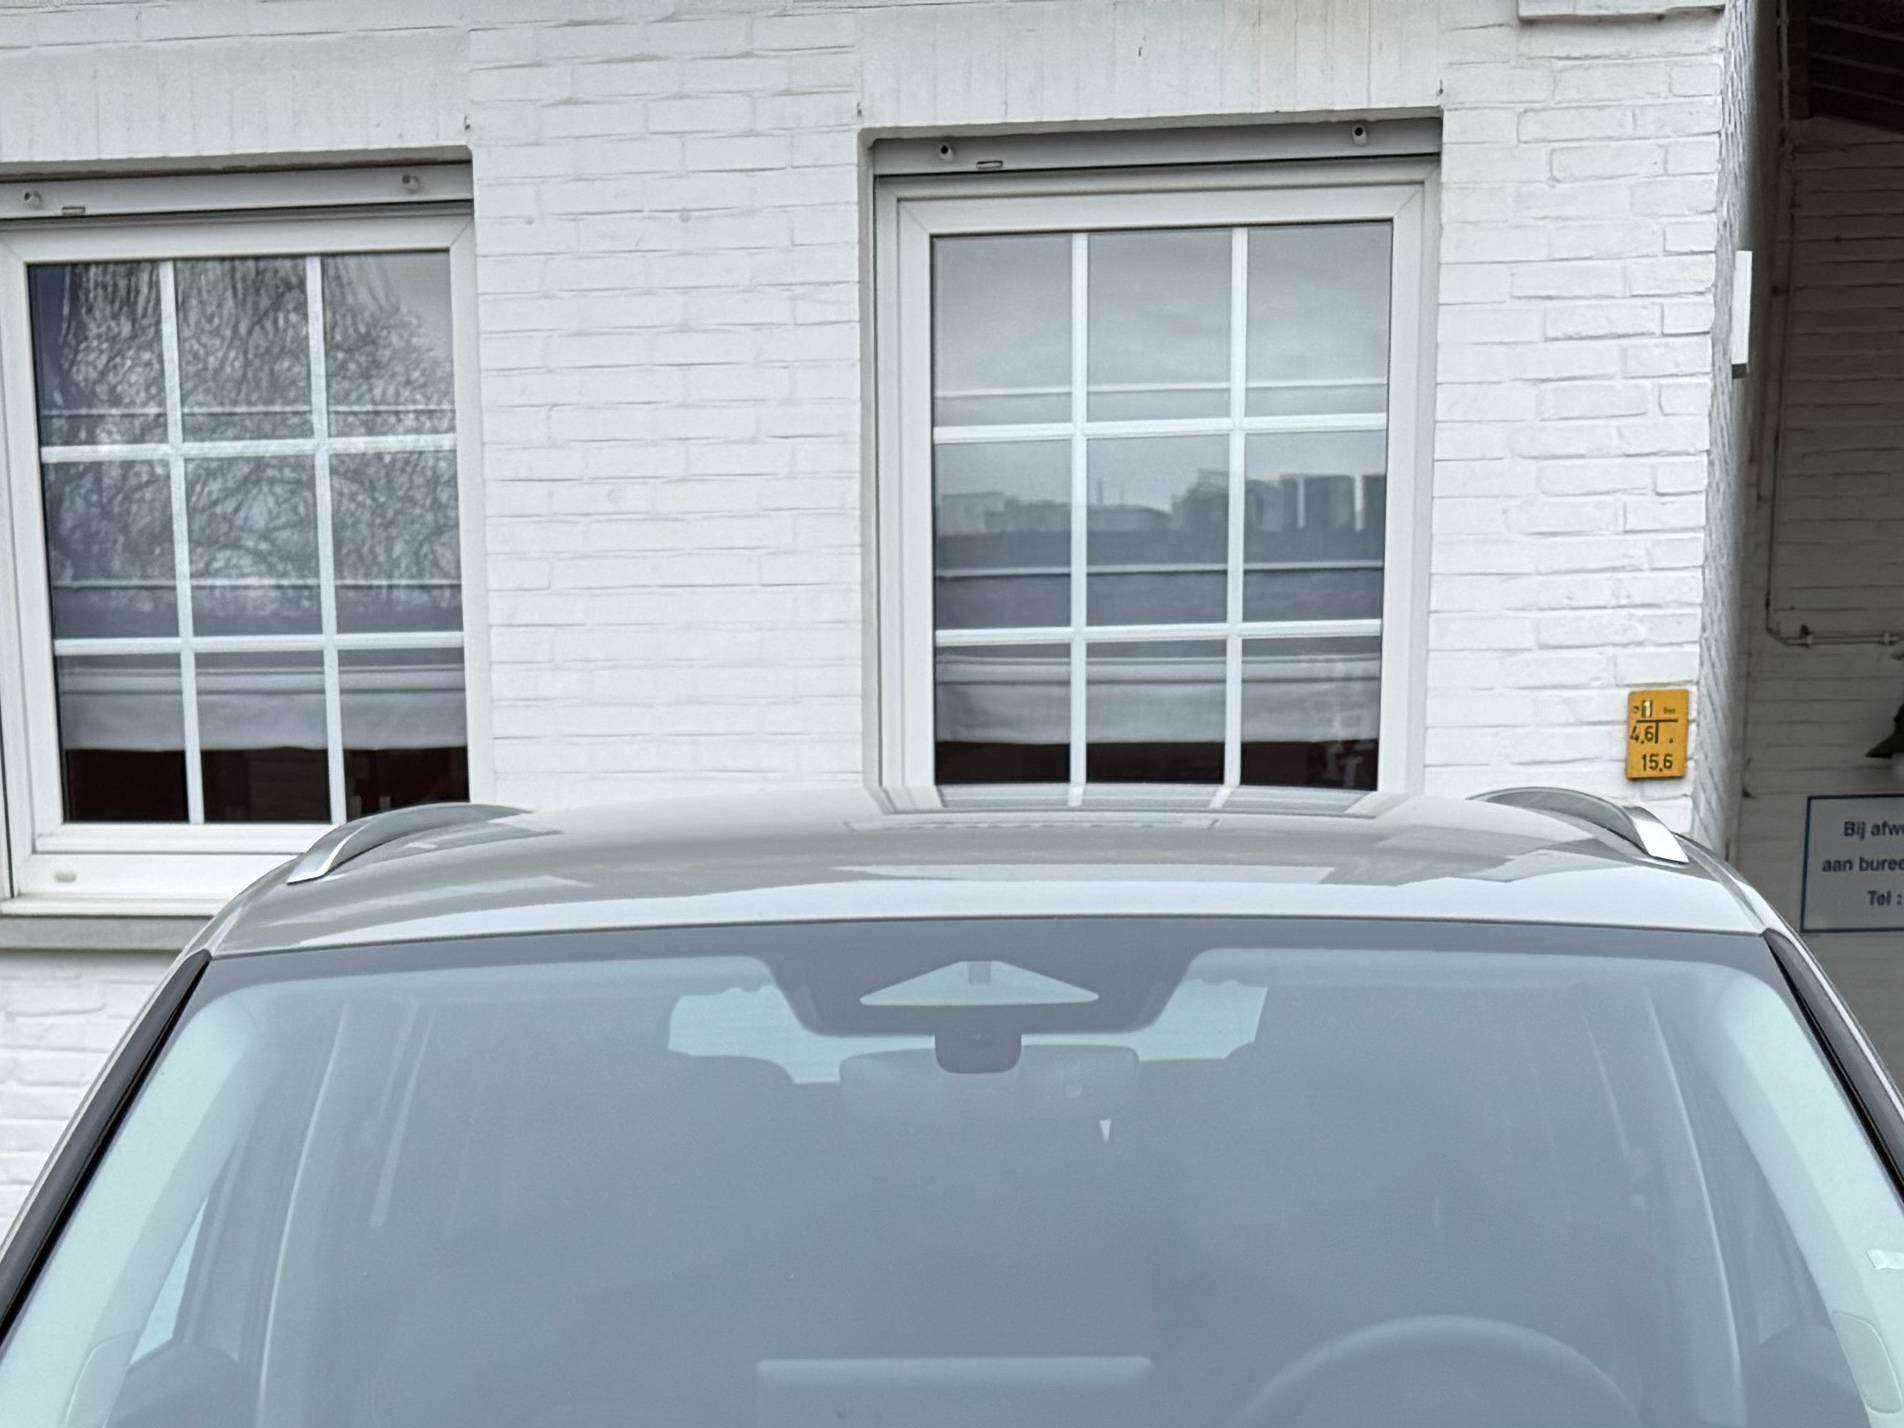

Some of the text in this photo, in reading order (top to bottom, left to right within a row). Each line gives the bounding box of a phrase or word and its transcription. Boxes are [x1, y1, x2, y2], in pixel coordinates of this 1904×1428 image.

[1642, 753, 1673, 772] 15.6
[1844, 820, 1866, 840] Bij
[1822, 858, 1853, 872] aan
[1868, 890, 1892, 906] Tel
